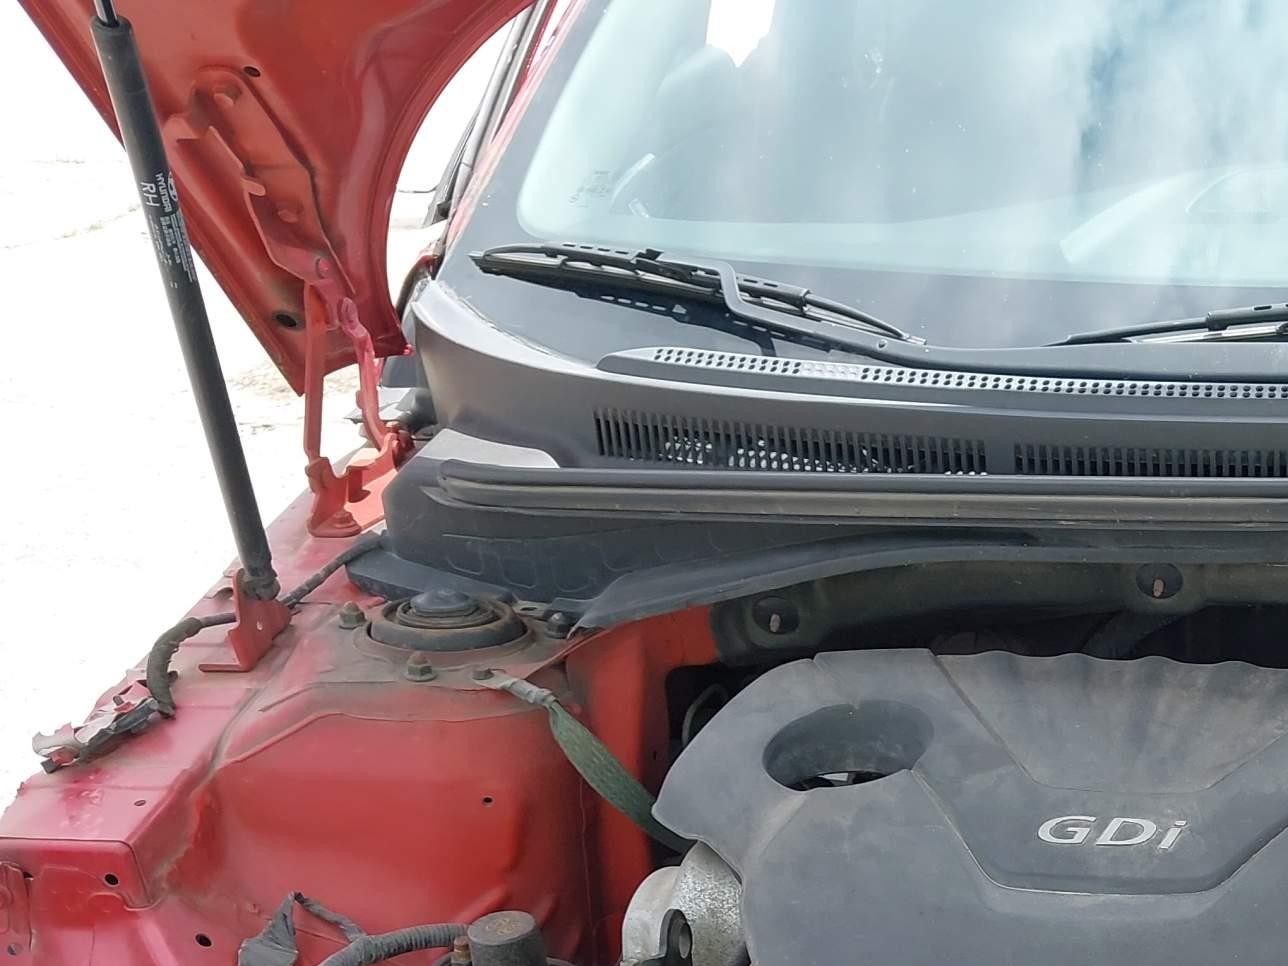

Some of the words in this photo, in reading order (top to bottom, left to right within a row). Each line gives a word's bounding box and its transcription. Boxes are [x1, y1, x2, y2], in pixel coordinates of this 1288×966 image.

[140, 181, 160, 207] RH
[155, 172, 173, 213] HYUNDAI
[1038, 815, 1188, 850] GDi
